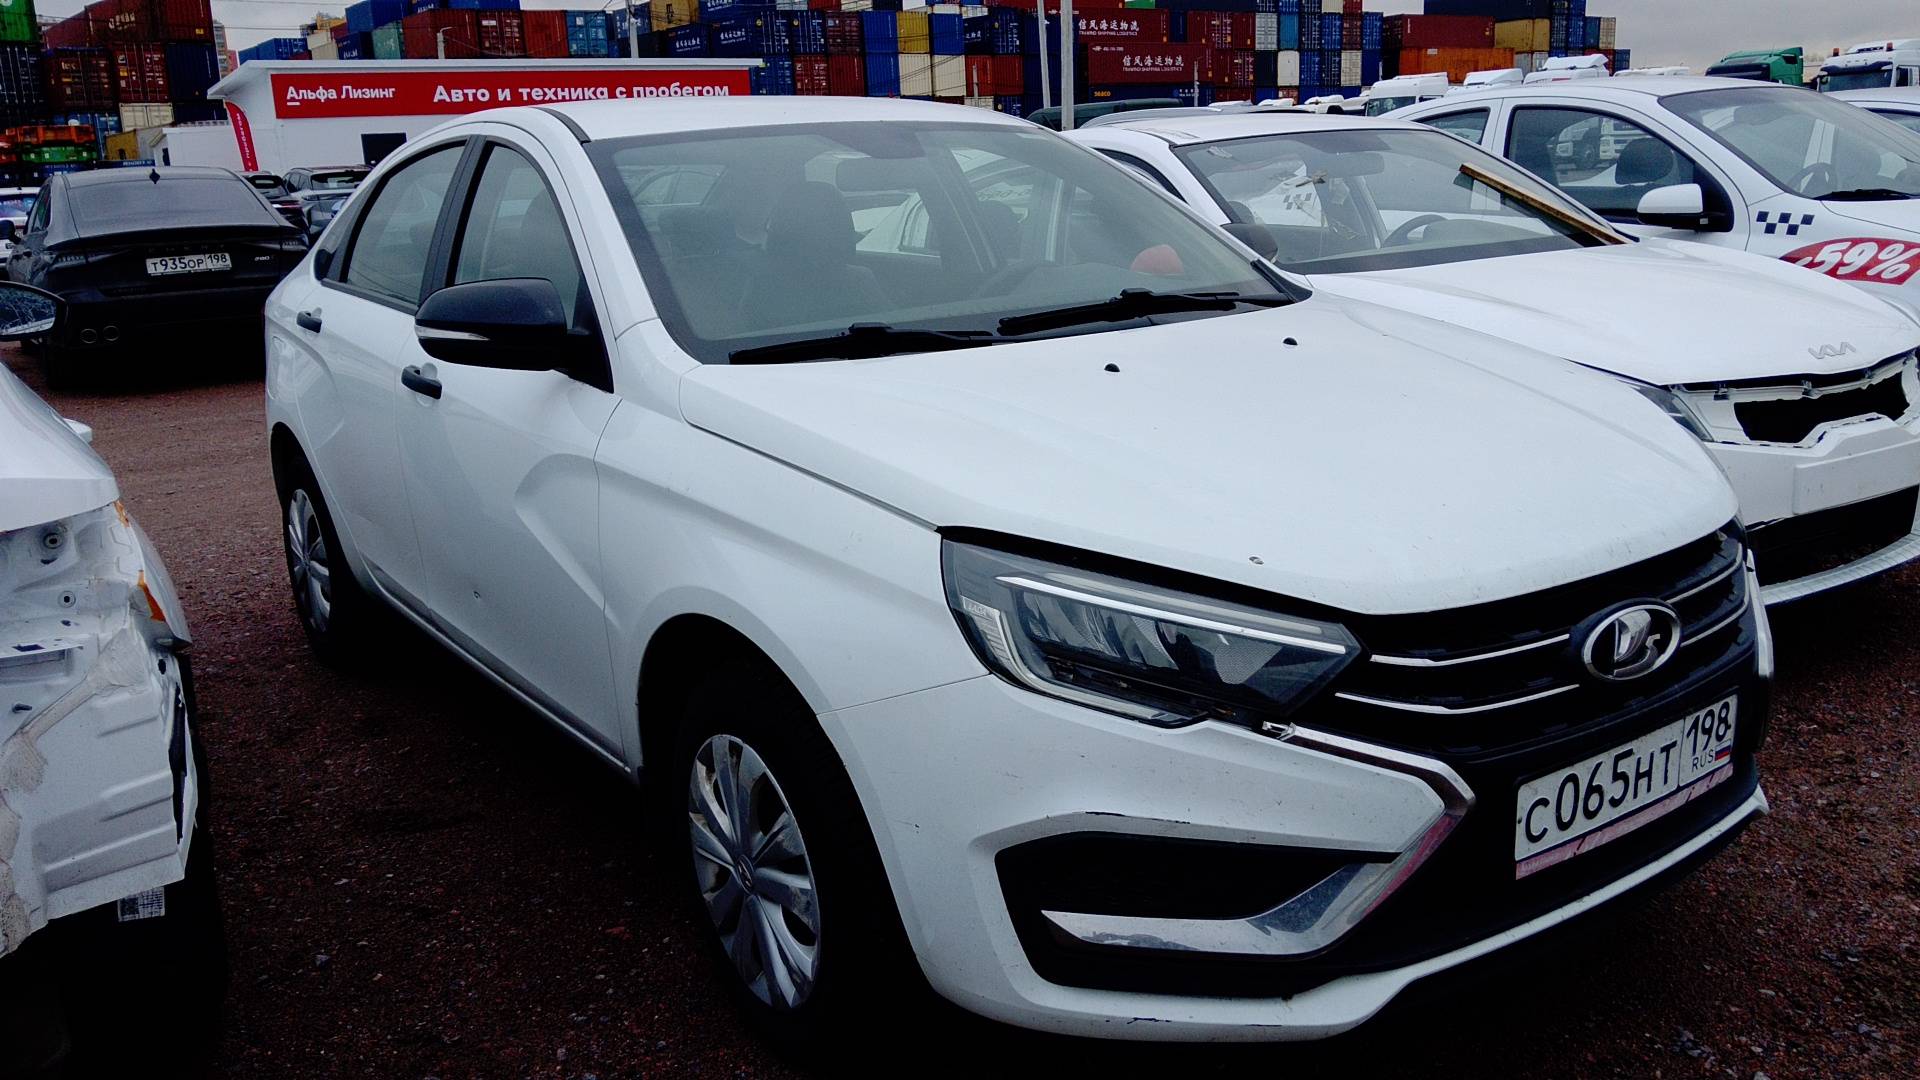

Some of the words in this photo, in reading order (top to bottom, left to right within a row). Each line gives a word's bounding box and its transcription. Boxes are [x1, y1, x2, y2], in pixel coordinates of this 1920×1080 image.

[286, 86, 337, 102] Альфа
[341, 85, 396, 99] Лизинг
[433, 85, 490, 102] Авто
[497, 88, 511, 101] и
[518, 86, 609, 101] техника
[615, 86, 627, 98] с
[632, 82, 729, 98] пробегом
[207, 254, 227, 264] 198
[1686, 701, 1732, 756] 198
[1691, 749, 1714, 771] RUS
[1524, 739, 1678, 844] С065НТ
